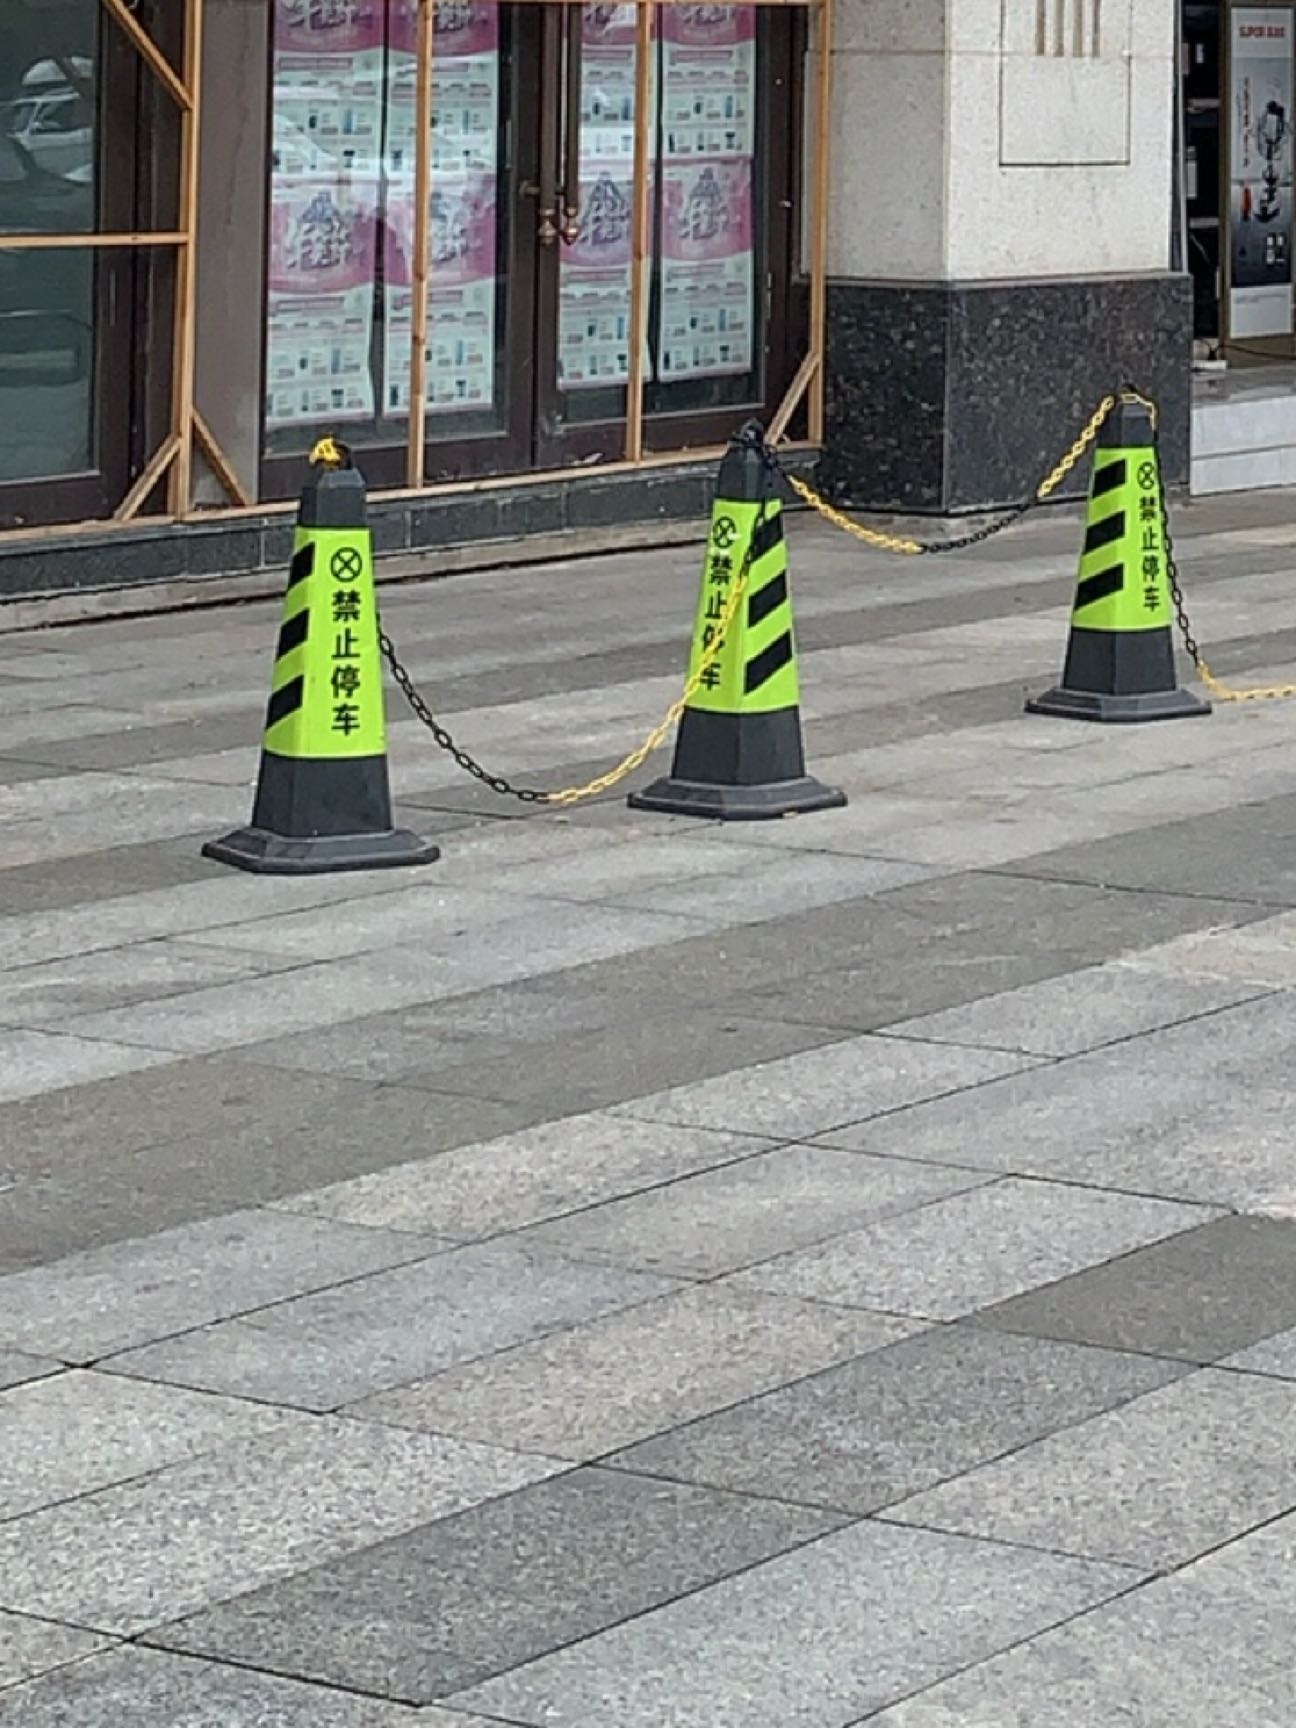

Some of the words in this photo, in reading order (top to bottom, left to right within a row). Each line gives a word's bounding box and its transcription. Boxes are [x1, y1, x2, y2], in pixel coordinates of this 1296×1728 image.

[1138, 496, 1161, 613] 禁止停车
[331, 588, 361, 736] 禁止停车
